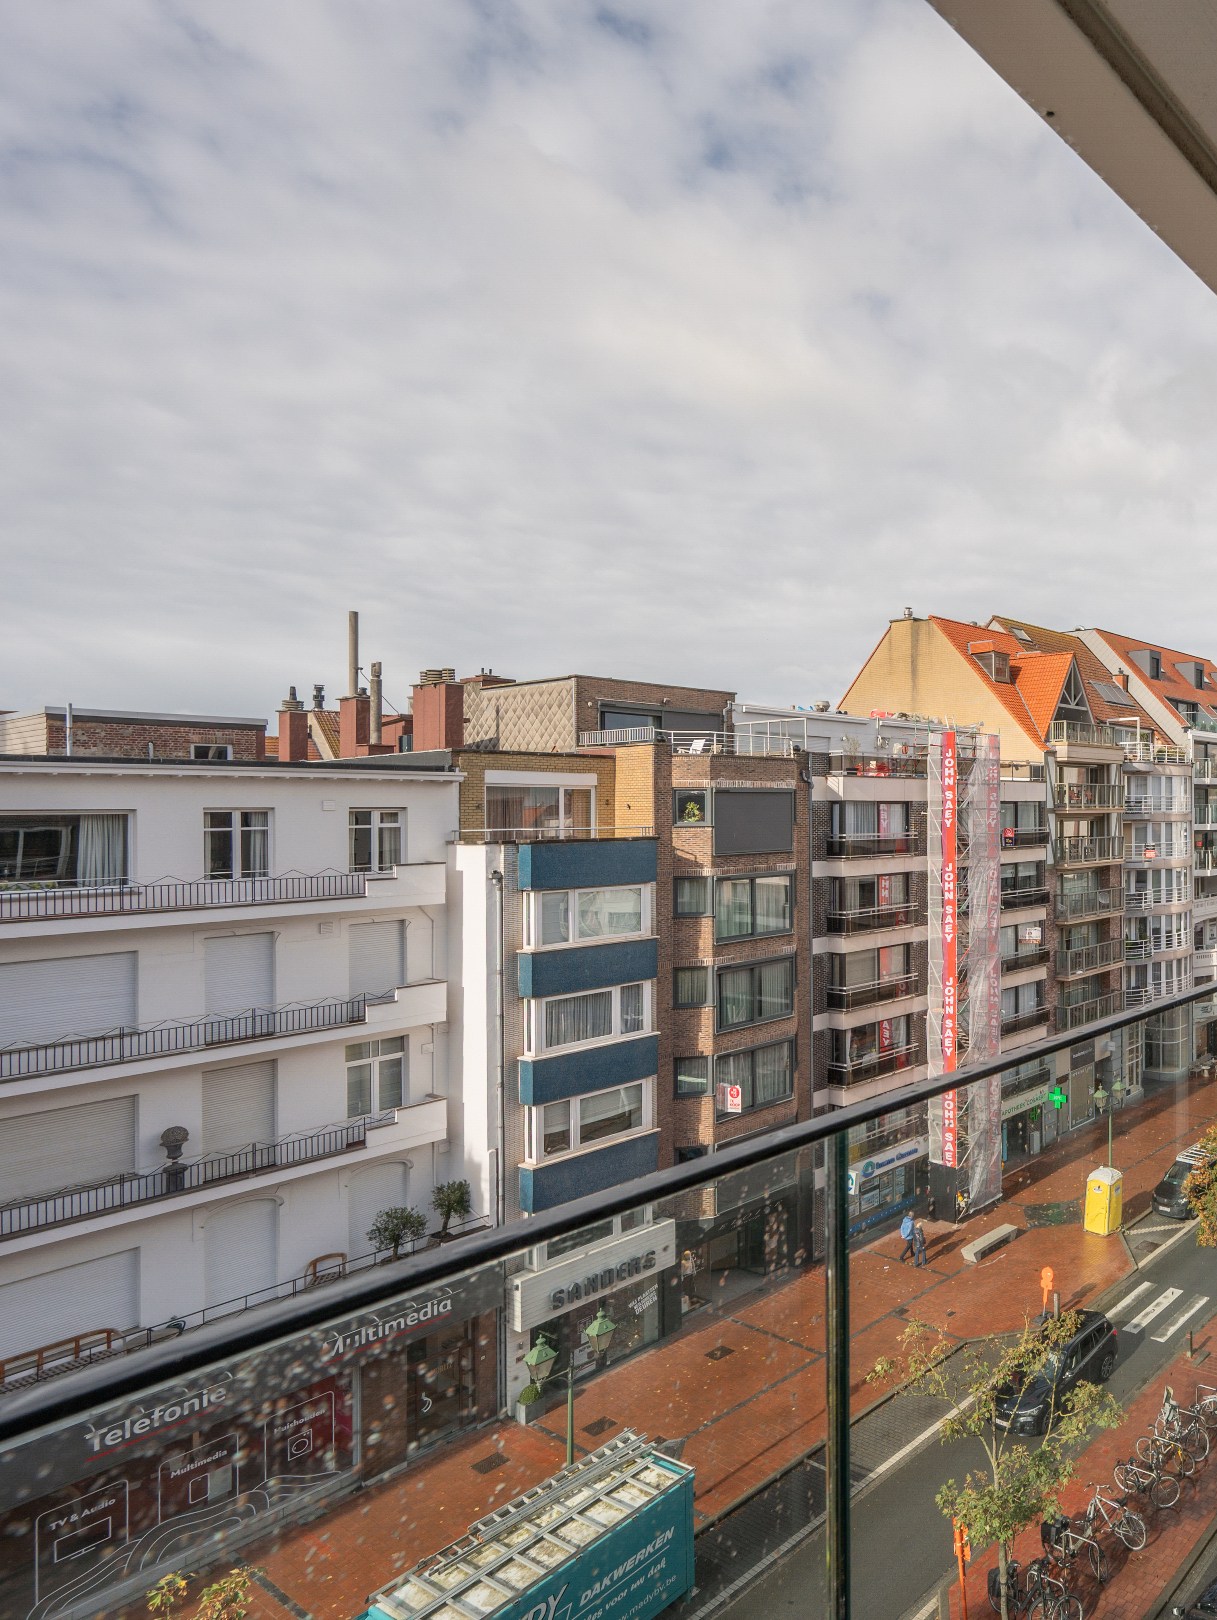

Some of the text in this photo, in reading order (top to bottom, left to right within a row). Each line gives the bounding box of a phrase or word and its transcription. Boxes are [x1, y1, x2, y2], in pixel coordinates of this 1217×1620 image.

[944, 748, 954, 828] JOHN SAEY
[944, 862, 954, 943] JOHN SAEY
[944, 977, 954, 1057] JOHN SAEY
[944, 1091, 954, 1168] JOHN SAEY
[322, 1299, 452, 1356] Multimedia
[84, 1387, 227, 1451] Telefonie
[170, 1450, 227, 1479] Multimedia
[50, 1498, 116, 1531] TV & Audio
[579, 1525, 675, 1607] DAKWERKEN
[605, 1589, 628, 1610] voor
[647, 1557, 667, 1579] dak
[619, 1574, 678, 1620] w.madybv.be
